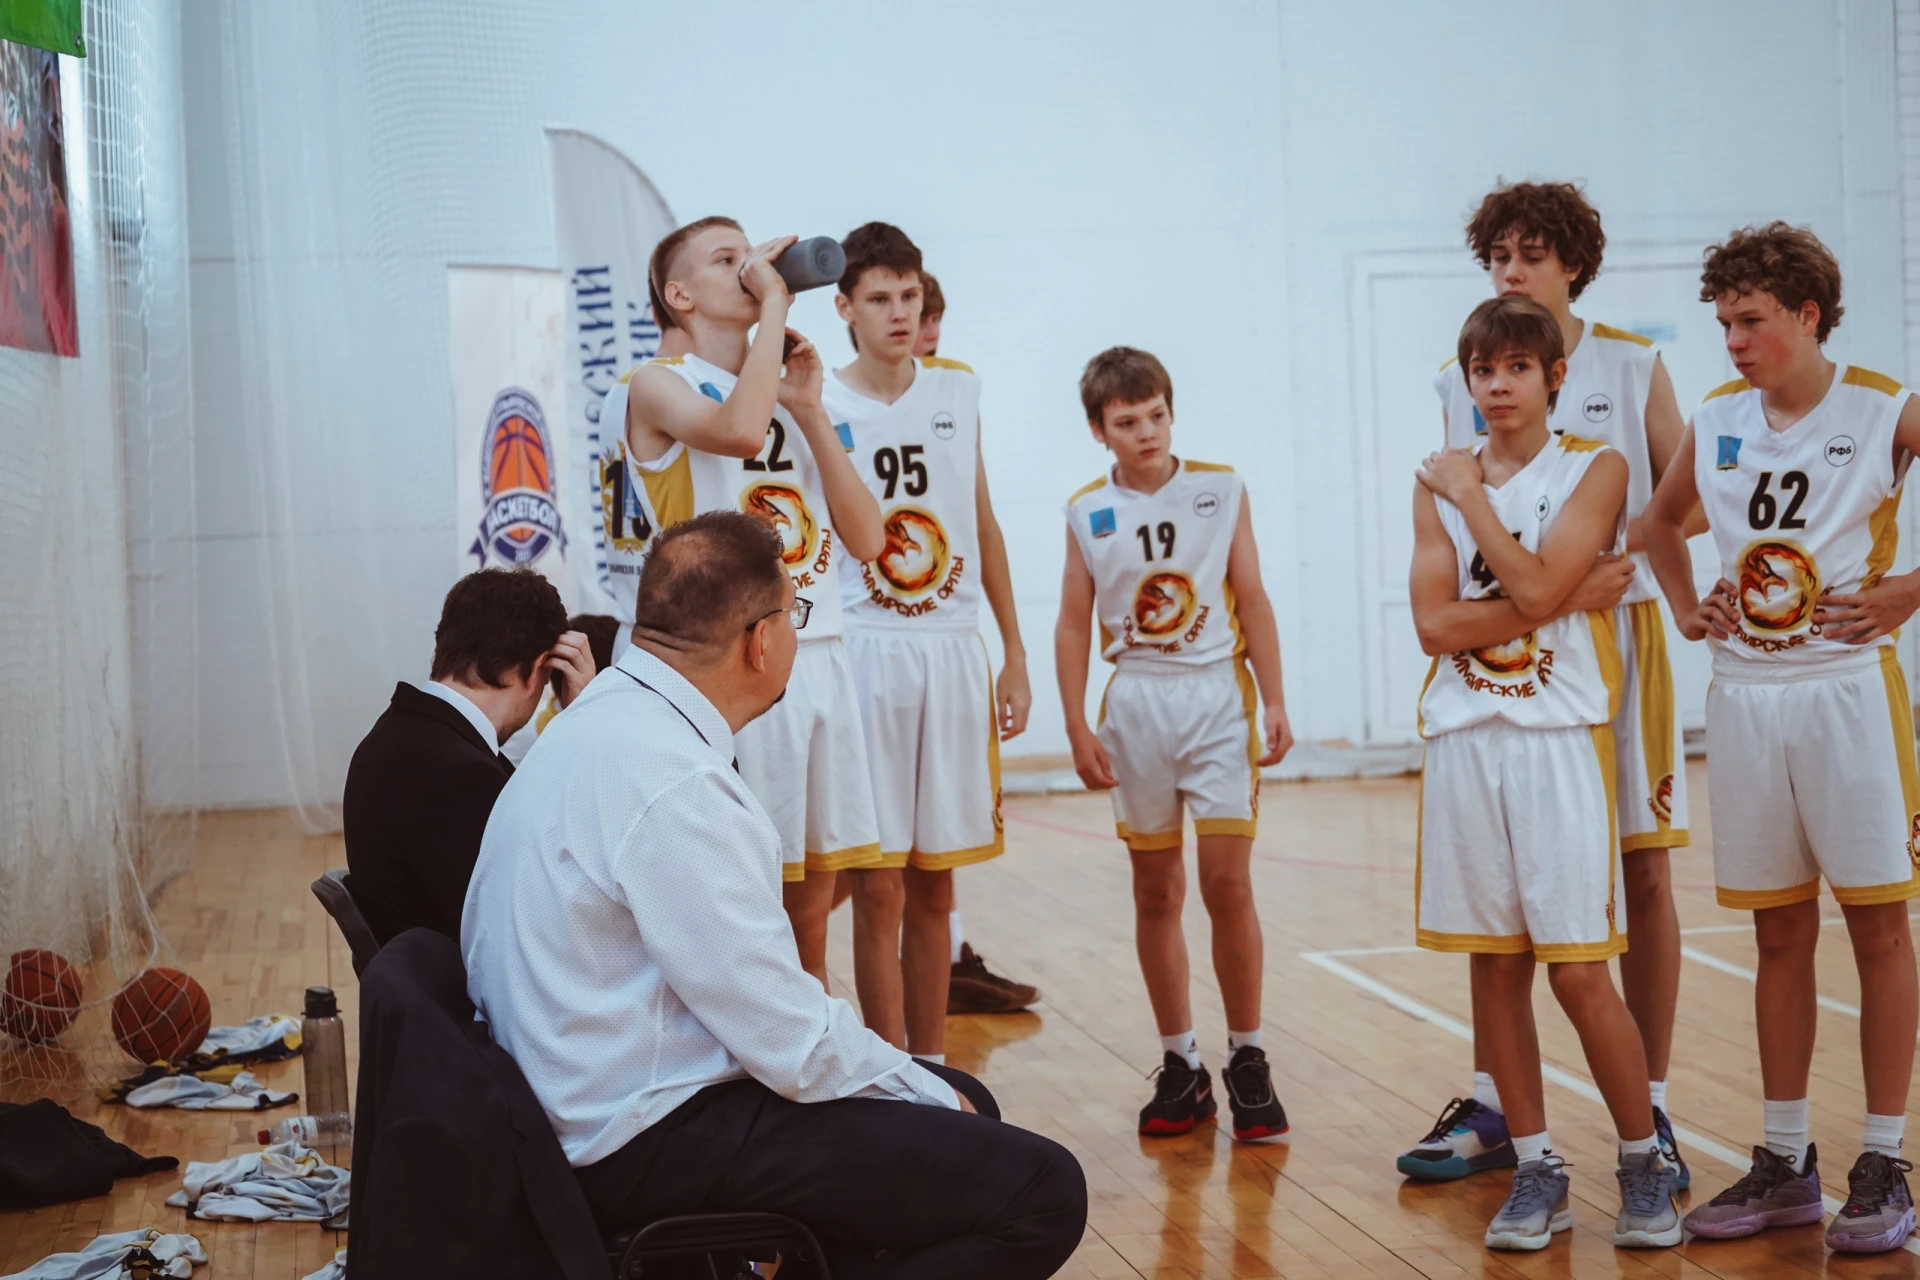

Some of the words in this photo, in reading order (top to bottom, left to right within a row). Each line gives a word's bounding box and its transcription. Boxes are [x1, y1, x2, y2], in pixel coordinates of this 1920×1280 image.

[934, 420, 954, 432] РФБ
[1586, 402, 1609, 414] РФБ
[1828, 445, 1852, 457] РФБ
[873, 445, 928, 500] 95
[1748, 470, 1810, 531] 62
[813, 529, 832, 574] ОРЛЫ
[1136, 521, 1176, 562] 19
[937, 556, 964, 600] ОРЛЫ
[1184, 604, 1210, 643] ОРЛЫ
[1452, 650, 1536, 698] ИМБИРСКИЕ
[1538, 649, 1555, 687] РЛЫ
